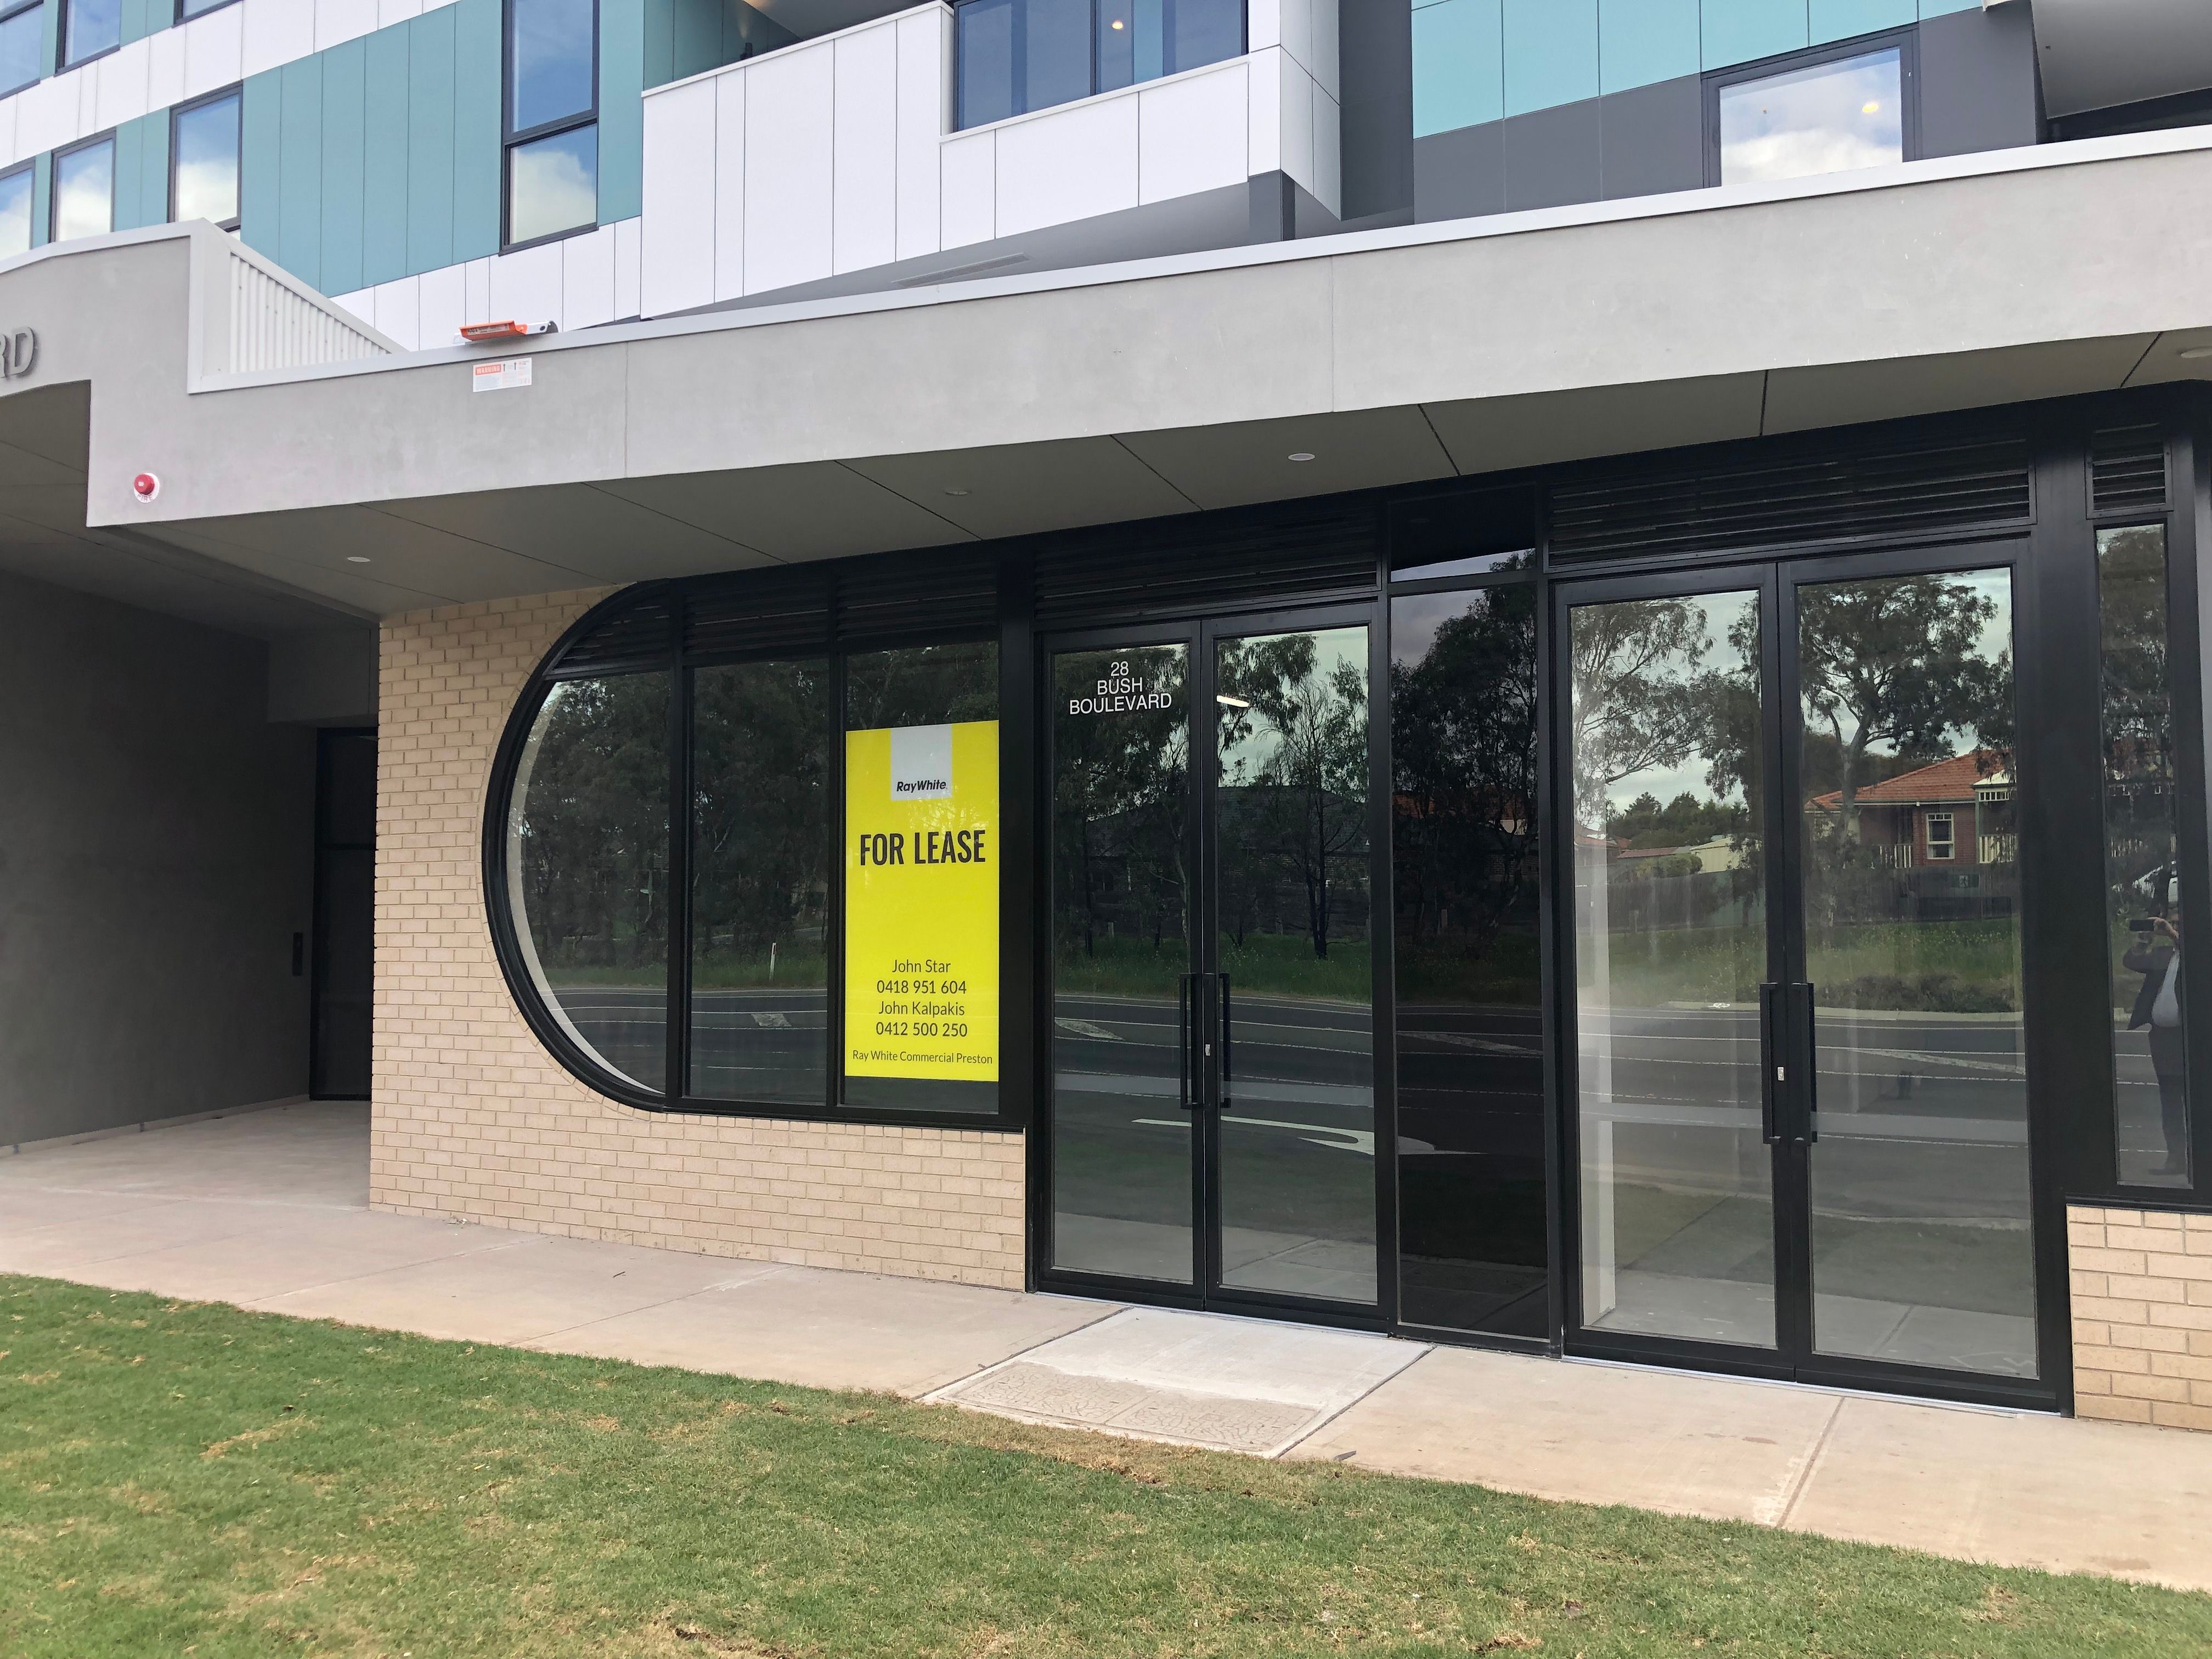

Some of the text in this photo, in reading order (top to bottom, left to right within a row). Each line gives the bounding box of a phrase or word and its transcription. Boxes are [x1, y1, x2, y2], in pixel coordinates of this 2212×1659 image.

[0, 326, 35, 378] D
[476, 365, 500, 374] WARNING
[137, 493, 153, 503] FIRE
[1110, 661, 1129, 676] 28
[1097, 677, 1142, 695] BUSH
[1070, 692, 1172, 715] BOULEVARD
[860, 830, 986, 866] FOR LEASE
[891, 959, 951, 973] John Star
[877, 980, 967, 994] 0418 951 604
[878, 1001, 965, 1018] John Kalpakis
[876, 1022, 968, 1037] 0412 500 250
[853, 1049, 992, 1064] Ray White Commercial Preston
